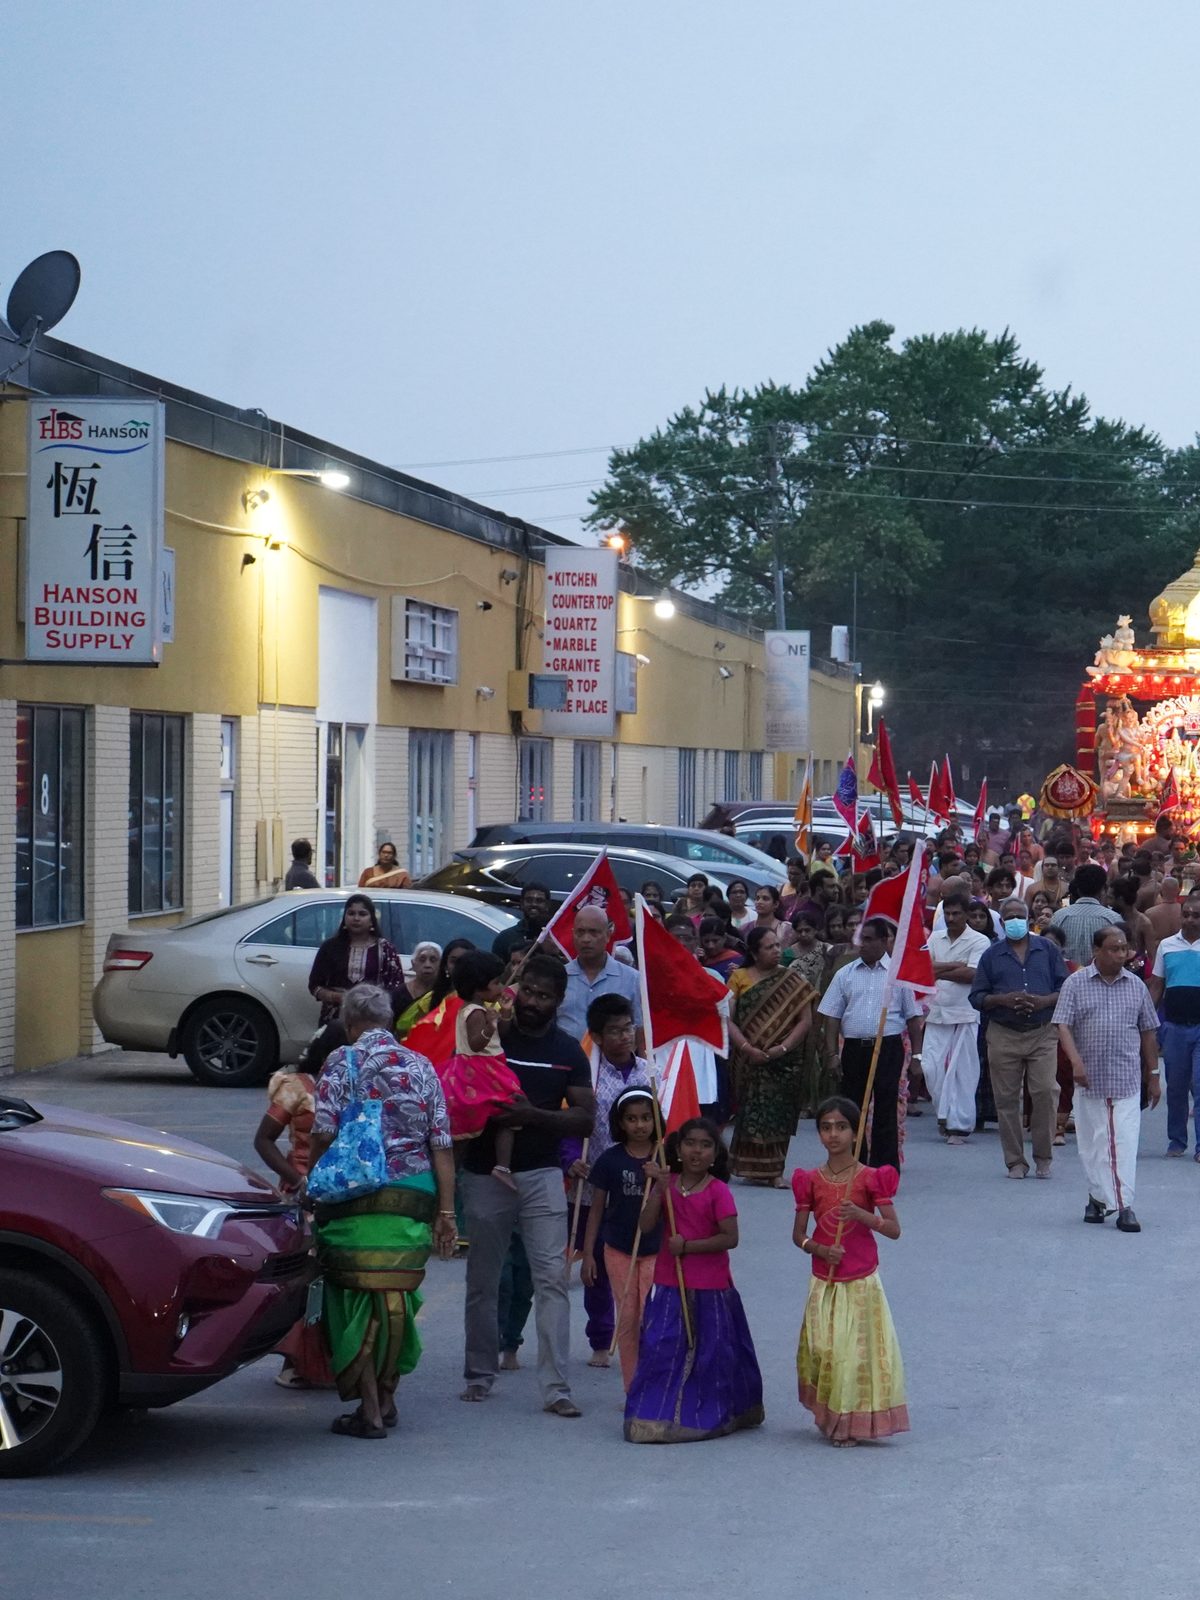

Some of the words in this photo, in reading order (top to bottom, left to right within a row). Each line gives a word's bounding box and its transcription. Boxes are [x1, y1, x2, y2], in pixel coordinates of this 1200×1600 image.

[39, 409, 83, 439] HBS
[88, 425, 149, 439] HANSON
[554, 572, 598, 587] KITCHEN
[43, 584, 138, 604] HANSON
[552, 594, 595, 609] COUNTER
[596, 595, 614, 609] TOP
[34, 607, 146, 627] BUILDING
[553, 617, 597, 631] QUARTZ
[46, 630, 135, 649] SUPPLY
[553, 638, 597, 652] MARBLE
[553, 658, 600, 672] GRANITE
[577, 679, 598, 693] TOP
[576, 699, 608, 713] PLACE
[41, 773, 49, 815] 8
